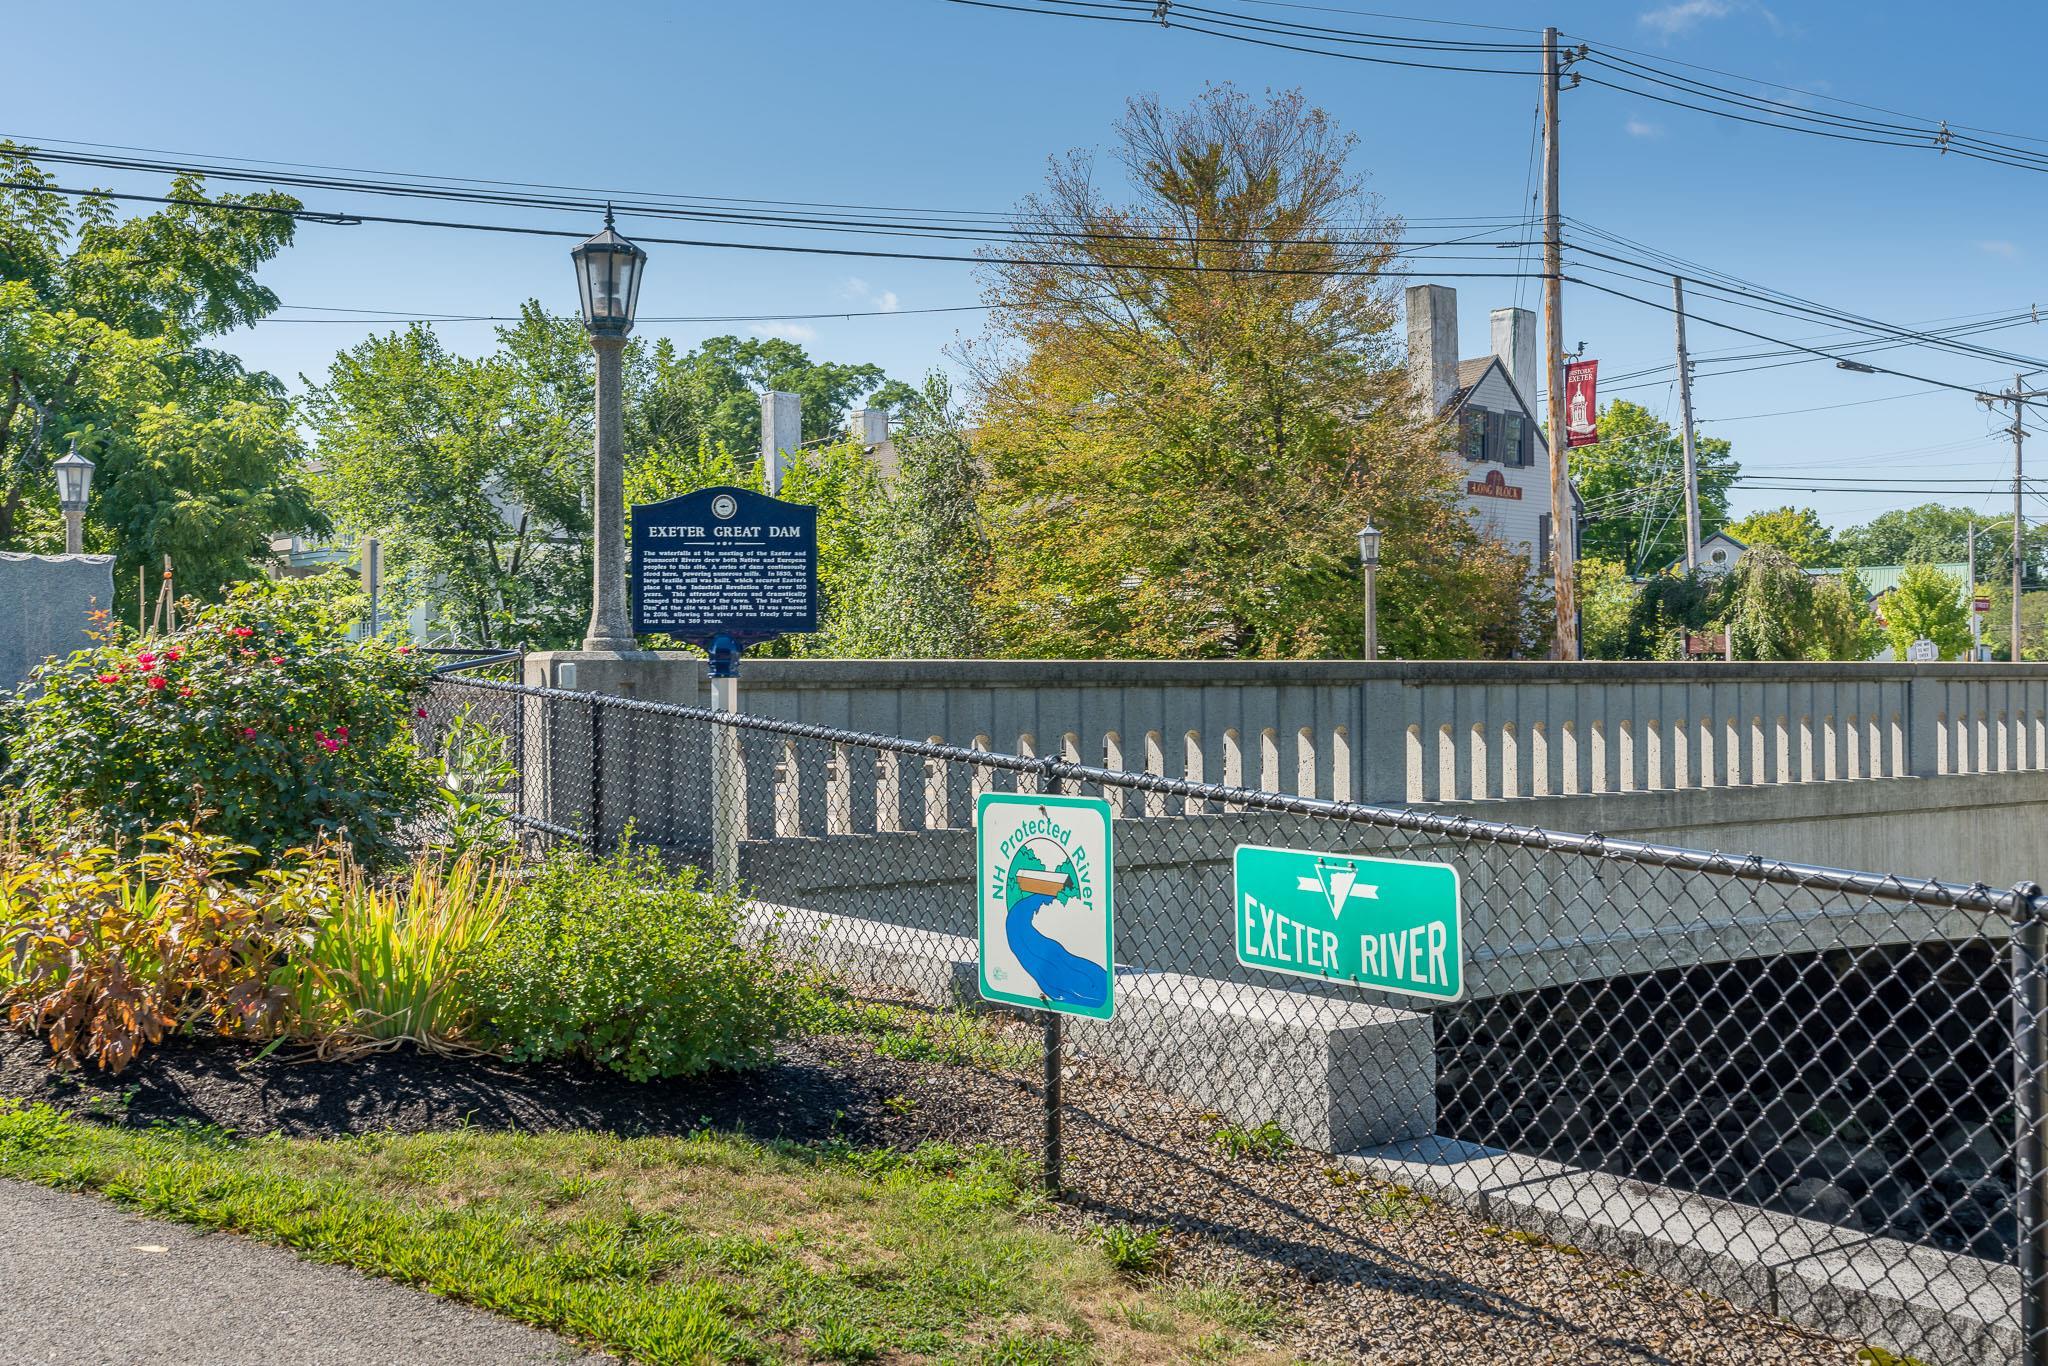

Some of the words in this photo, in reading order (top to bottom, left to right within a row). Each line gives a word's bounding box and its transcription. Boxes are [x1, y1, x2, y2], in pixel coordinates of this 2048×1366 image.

[1568, 374, 1593, 383] EXETER
[648, 526, 706, 538] EXETER
[713, 526, 761, 538] GREAT
[769, 526, 801, 538] DAM
[992, 864, 1006, 900] NH
[1000, 817, 1072, 860] Protected
[1072, 844, 1093, 912] River
[1244, 892, 1339, 970] EXETER
[1360, 920, 1449, 987] RIVER
